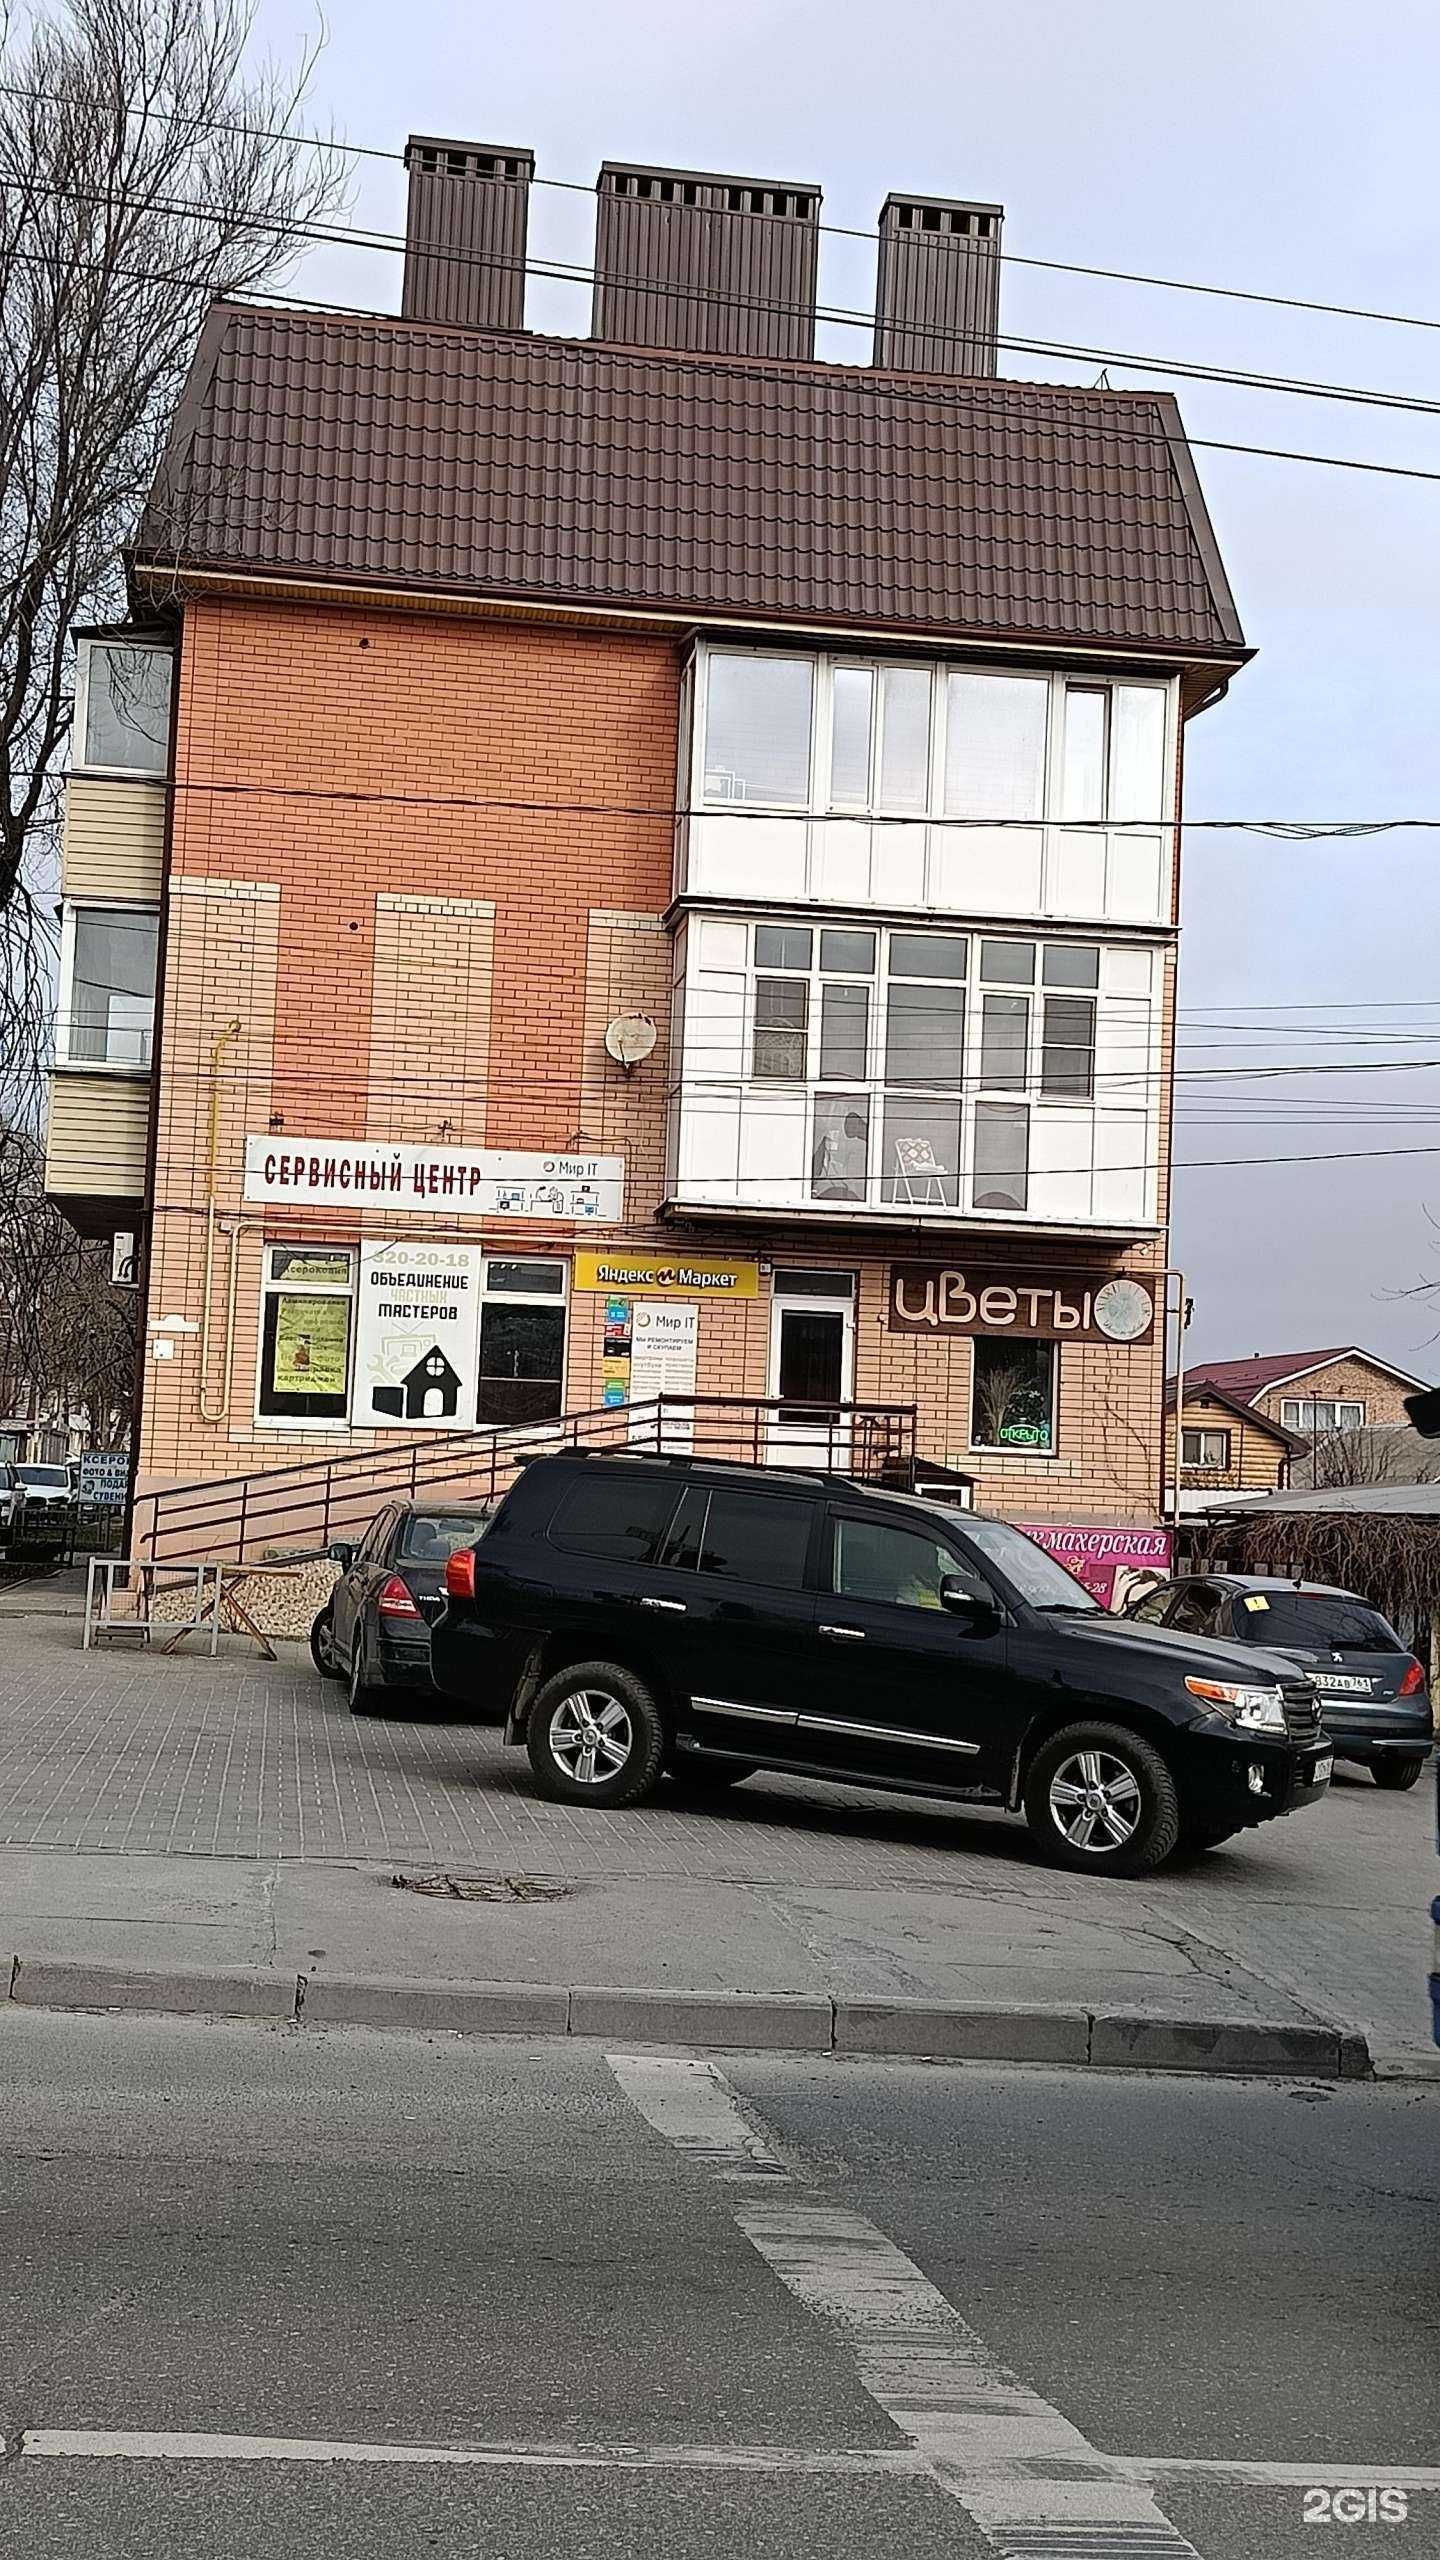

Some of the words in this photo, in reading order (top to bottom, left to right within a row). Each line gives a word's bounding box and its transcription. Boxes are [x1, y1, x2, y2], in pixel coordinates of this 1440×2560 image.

[264, 1152, 402, 1192] СЕРВИСНЫЙ
[413, 1163, 481, 1198] ЦЕНТР
[559, 1161, 584, 1178] Мир
[371, 1271, 469, 1290] ОБЪЕДИНЕНИЕ
[597, 1265, 654, 1284] Яндекс
[678, 1268, 738, 1288] Маркет
[378, 1304, 458, 1320] МАСТЕРОВ
[655, 1315, 681, 1330] Мир
[684, 1316, 695, 1329] IT
[1000, 1428, 1049, 1441] ОТКРЫТО
[83, 1467, 106, 1477] ФОТО
